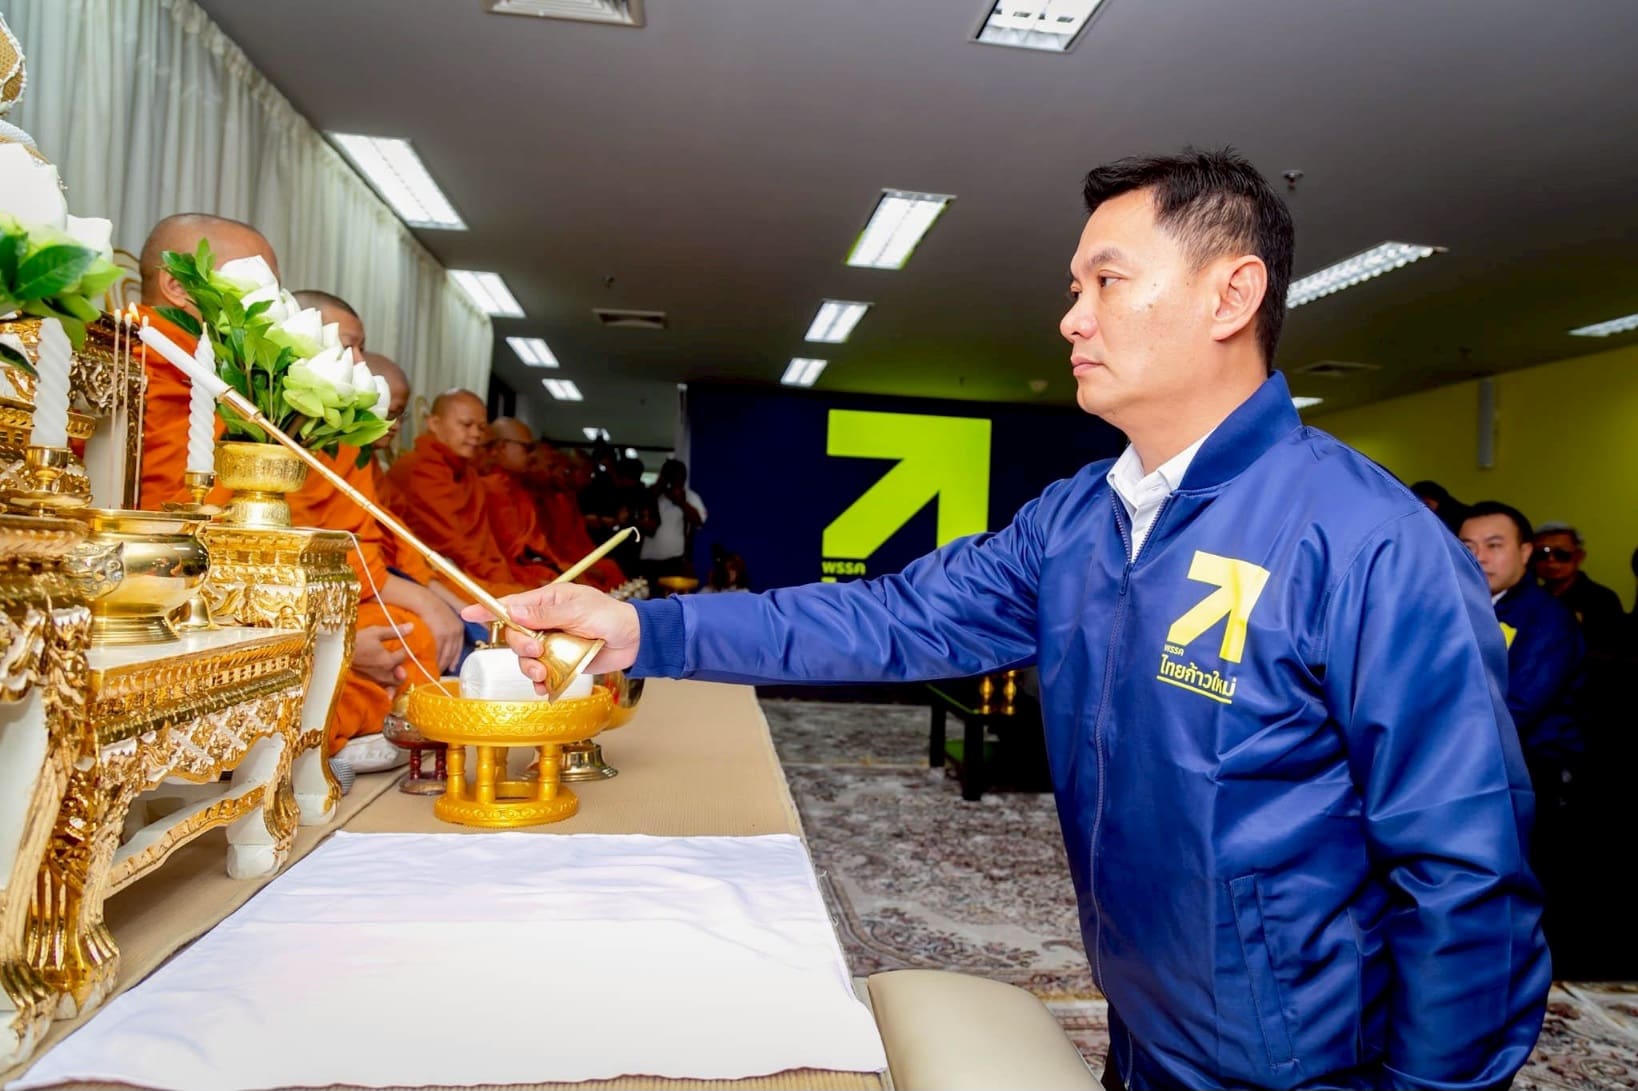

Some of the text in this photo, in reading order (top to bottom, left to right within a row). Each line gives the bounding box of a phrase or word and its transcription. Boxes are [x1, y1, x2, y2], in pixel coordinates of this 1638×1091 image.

[1160, 654, 1237, 697] ไทยก้าวใหม่
